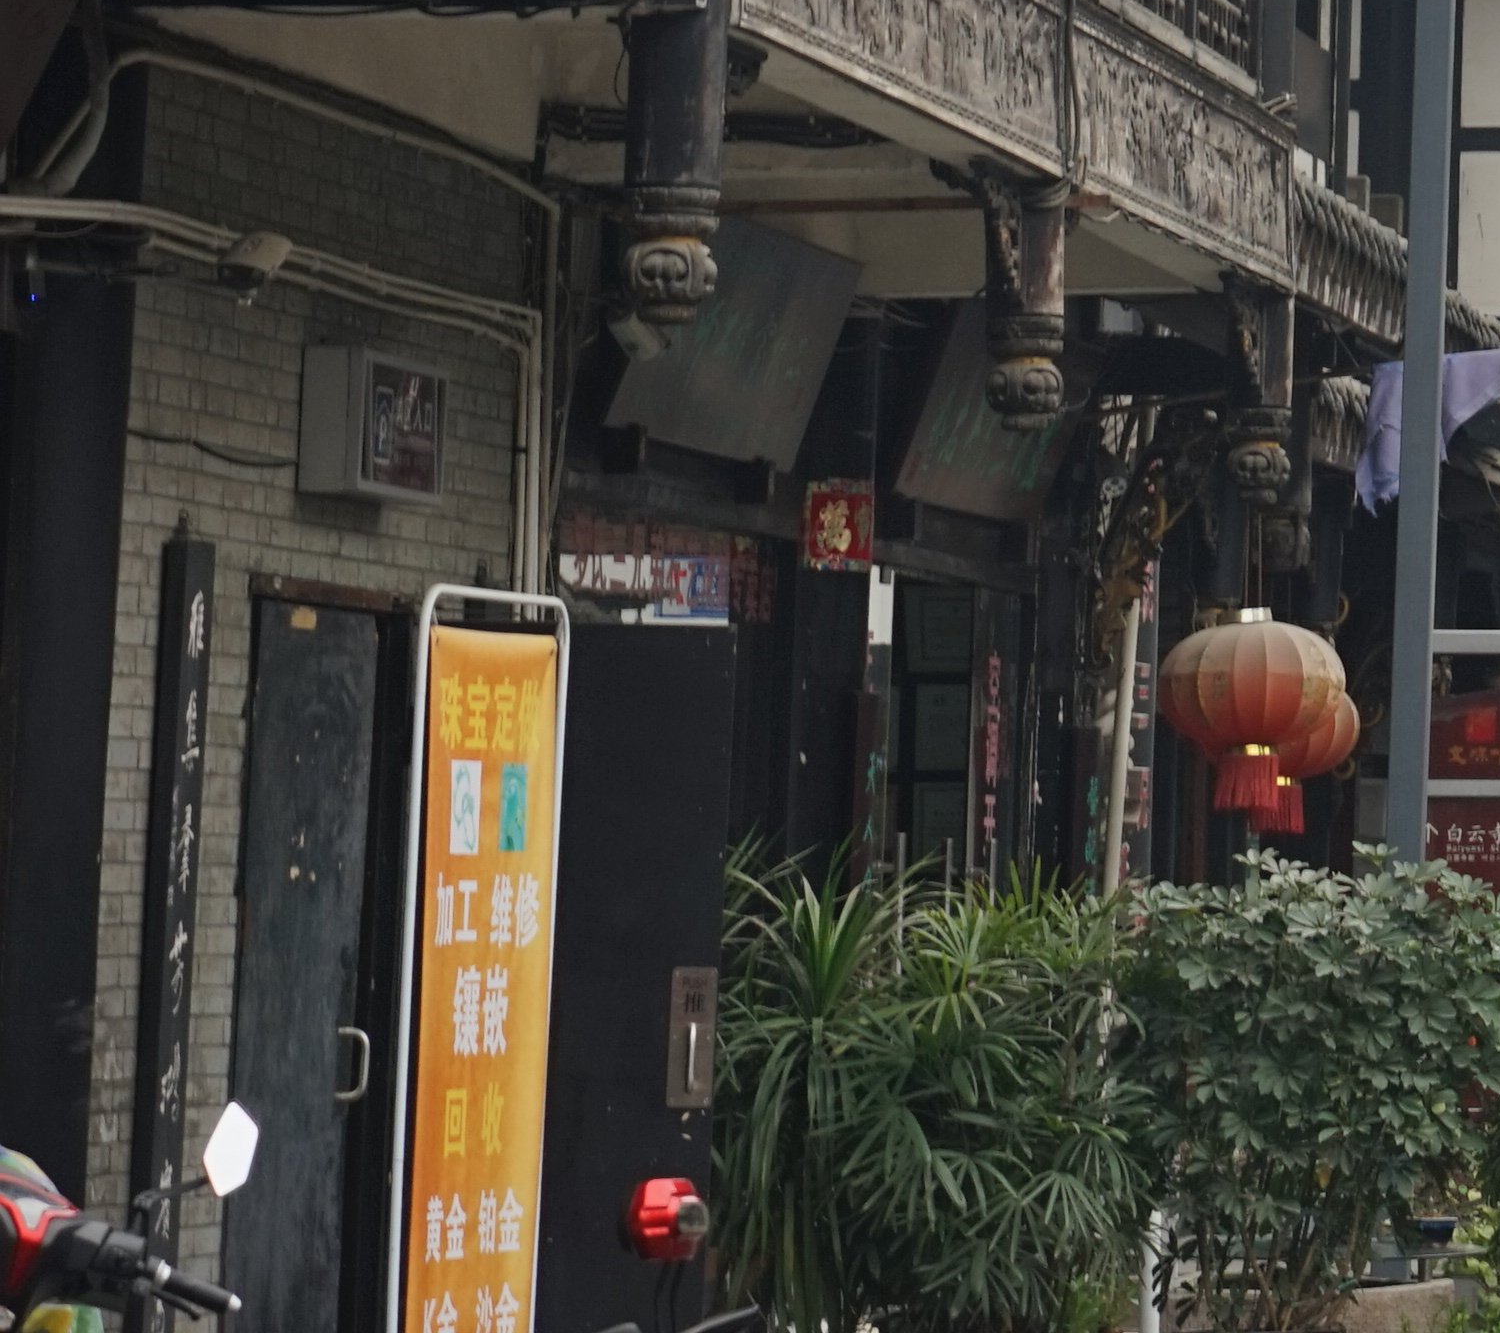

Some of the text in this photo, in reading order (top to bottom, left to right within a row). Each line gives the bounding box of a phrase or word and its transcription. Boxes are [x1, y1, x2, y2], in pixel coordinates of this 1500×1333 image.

[438, 673, 540, 751] 珠宝定做
[434, 871, 539, 949] 加工 维修
[453, 963, 508, 1057] 镶嵌
[684, 991, 706, 1013] 推
[443, 1082, 504, 1159] 回收
[425, 1186, 524, 1263] 黄金 铂金
[423, 1282, 520, 1333] K金 沙金
